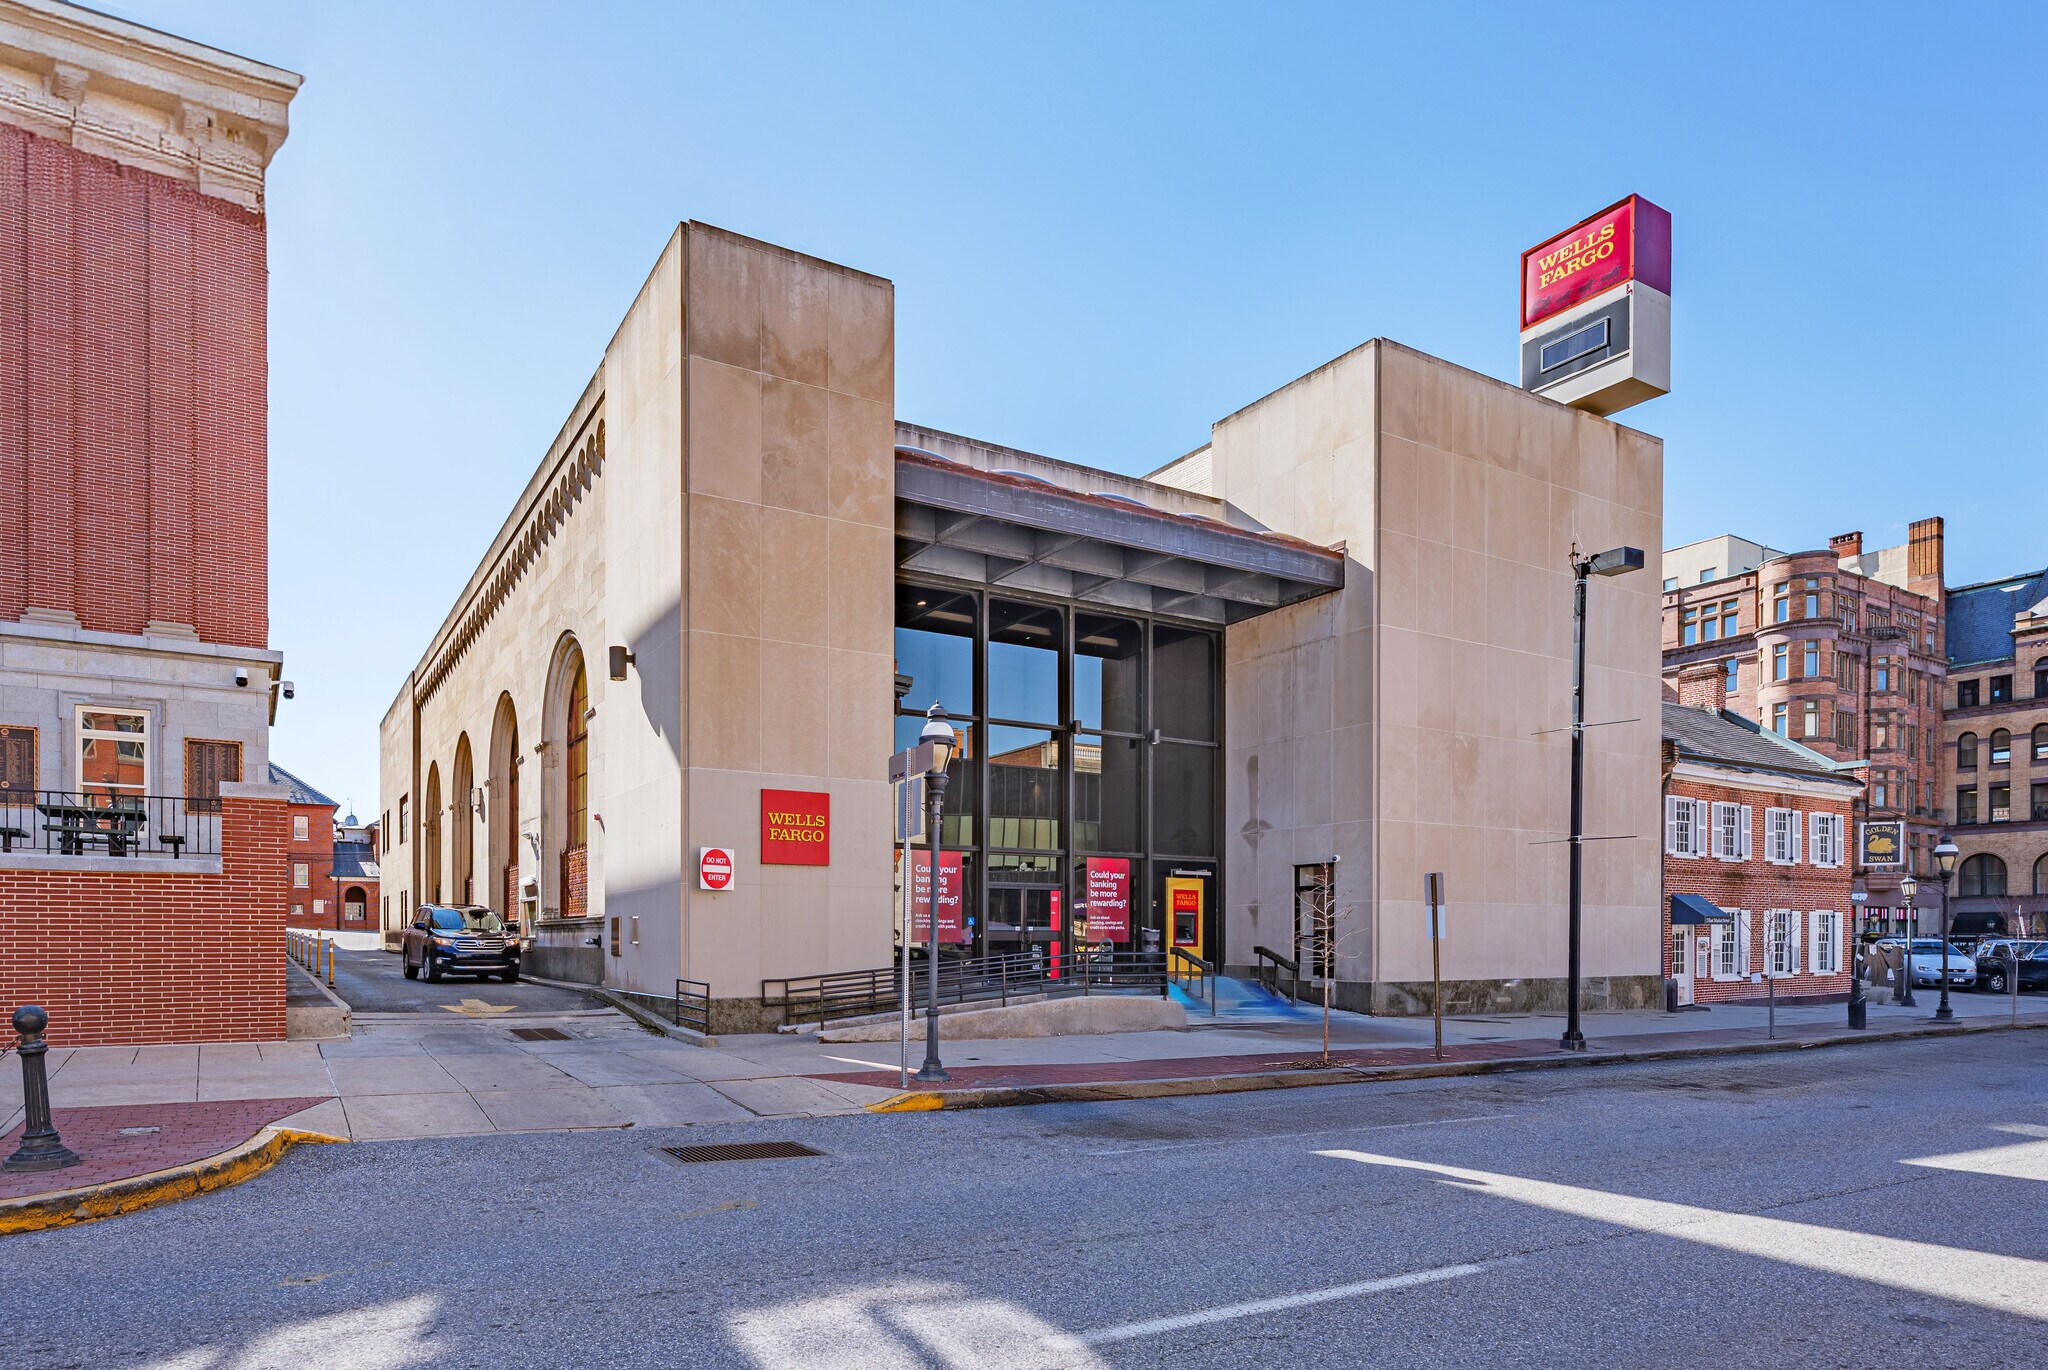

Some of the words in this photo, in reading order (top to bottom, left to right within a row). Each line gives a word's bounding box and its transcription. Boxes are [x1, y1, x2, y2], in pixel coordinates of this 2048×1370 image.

[1537, 222, 1615, 272] WELLS
[1539, 241, 1614, 290] FARGO
[768, 812, 826, 827] WELLS
[769, 828, 825, 843] FARGO
[1865, 826, 1899, 836] GOLDEN
[1869, 855, 1894, 863] SWAN
[915, 864, 931, 873] Cou
[939, 866, 957, 875] your
[915, 874, 947, 886] banng
[1090, 870, 1110, 879] Could
[1110, 872, 1125, 880] your
[915, 884, 926, 893] be
[1090, 880, 1117, 890] banking
[1090, 889, 1099, 898] be
[915, 896, 959, 906] rewding?
[1090, 899, 1127, 909] rewarding?
